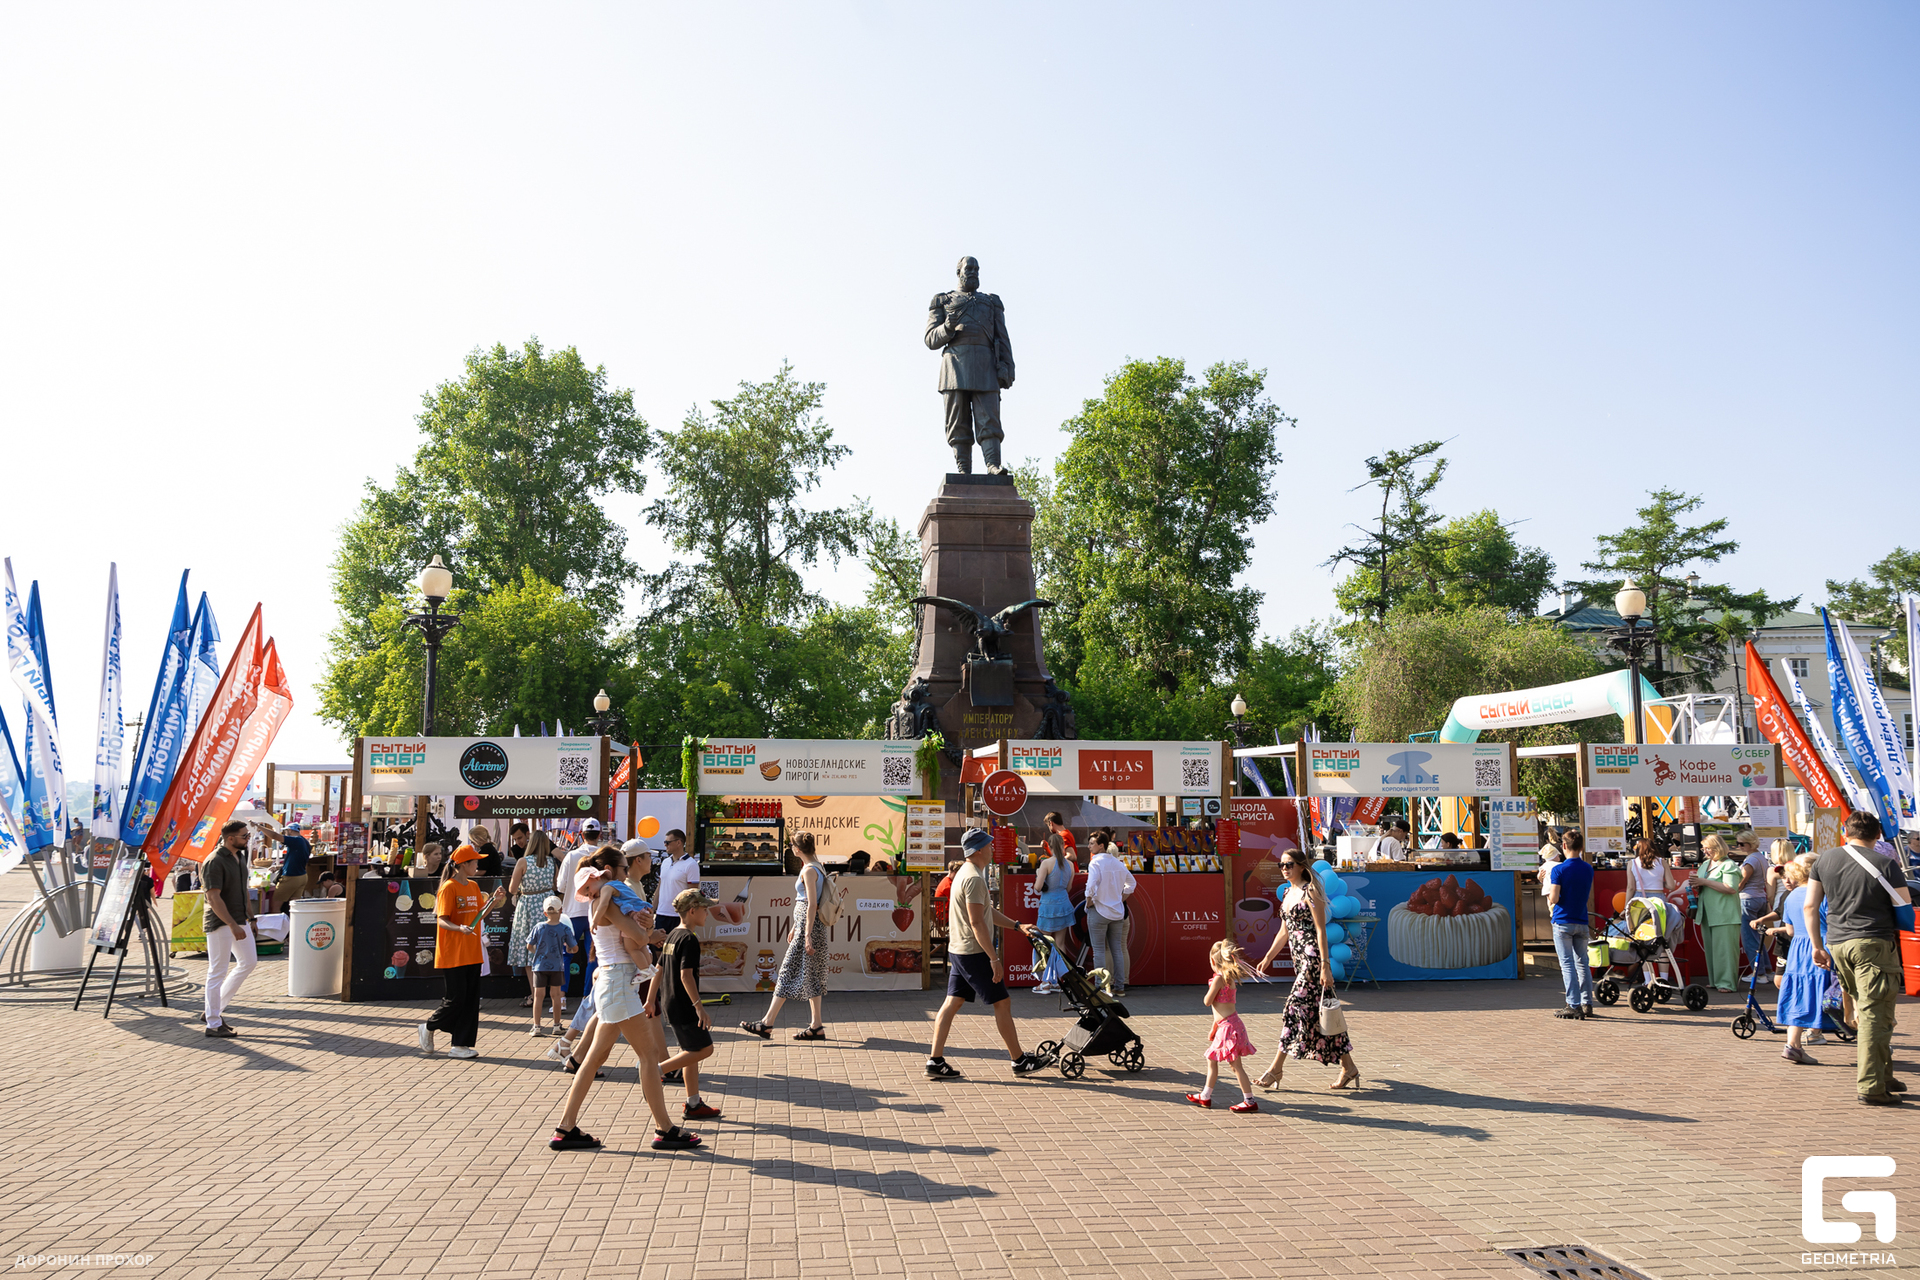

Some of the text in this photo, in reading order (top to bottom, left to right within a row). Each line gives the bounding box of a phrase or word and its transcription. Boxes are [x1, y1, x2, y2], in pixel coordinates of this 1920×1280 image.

[1479, 692, 1574, 719] СЫТЫЙ БАБР
[963, 713, 1014, 724] ИМПЕРАТОРУ
[150, 702, 181, 784] ЛЮБИМ
[371, 742, 426, 753] СЫТЫЙ
[1880, 722, 1901, 764] ДНЁМ
[215, 724, 267, 803] ЛЮБИМЫЙ
[263, 695, 283, 731] ГОР
[704, 743, 756, 755] СЫТЫЙ
[1012, 746, 1062, 757] СЫТЫЙ
[1312, 748, 1360, 759] СЫТЫЙ
[1594, 745, 1639, 755] СЫТЫЙ
[1744, 749, 1770, 758] СБЕР
[370, 753, 426, 766] БАБР
[462, 757, 506, 772] Alcrème
[703, 755, 756, 767] БАБР
[786, 759, 867, 770] НОВОЗЕЛАНДСКИЕ
[1012, 757, 1062, 769] БАБР
[1312, 759, 1360, 770] БАБР
[1595, 755, 1639, 767] БАБР
[181, 790, 190, 805] С
[187, 736, 215, 792] ДНЁМ
[187, 716, 242, 817] ЛЮБИМЫЙ
[1089, 760, 1144, 773] ATLAS
[1679, 760, 1716, 773] Кофе
[1892, 765, 1903, 776] С
[785, 771, 820, 781] ПИРОГИ
[1381, 774, 1440, 784] KADE
[1680, 773, 1732, 783] Машина
[985, 785, 1026, 795] ATLAS
[492, 807, 568, 817] которое греет
[1229, 803, 1267, 812] ШКОЛА
[1369, 796, 1386, 820] ЛЮБИ
[1229, 812, 1275, 821] БАРИСТА
[786, 816, 861, 829] ЗЕЛАНДСКИЕ
[1492, 812, 1502, 869] ВКУСНОЕ
[859, 901, 890, 909] сладкие
[1172, 911, 1219, 921] ATLAS
[719, 926, 747, 935] сытные
[757, 915, 862, 943] ПИГИ
[1009, 964, 1034, 972] ОБЖА
